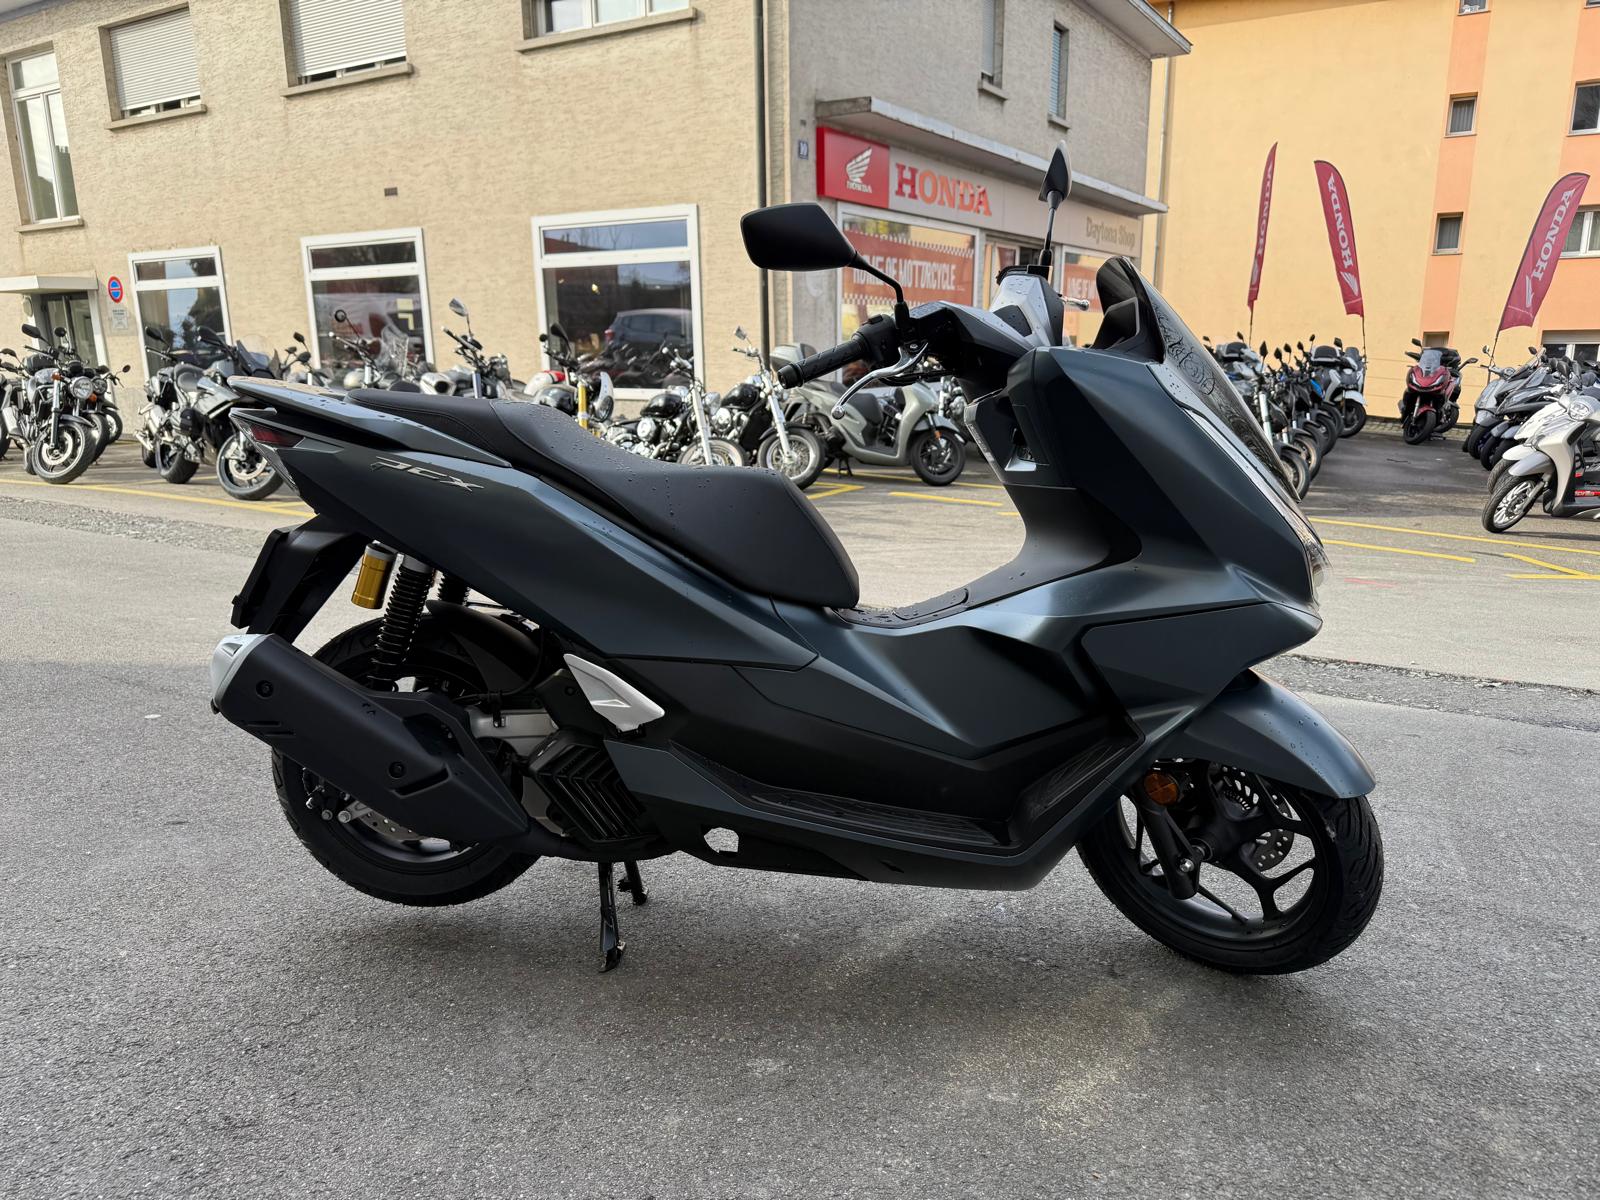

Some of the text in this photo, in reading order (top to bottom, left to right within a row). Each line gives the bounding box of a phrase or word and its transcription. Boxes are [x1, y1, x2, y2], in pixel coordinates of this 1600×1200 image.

[846, 181, 873, 194] HONDA
[895, 163, 992, 216] HONDA
[1086, 216, 1136, 250] Daytona Shop
[1327, 172, 1354, 269] HONDA
[1531, 188, 1576, 281] HONDA
[370, 456, 485, 492] PCX
